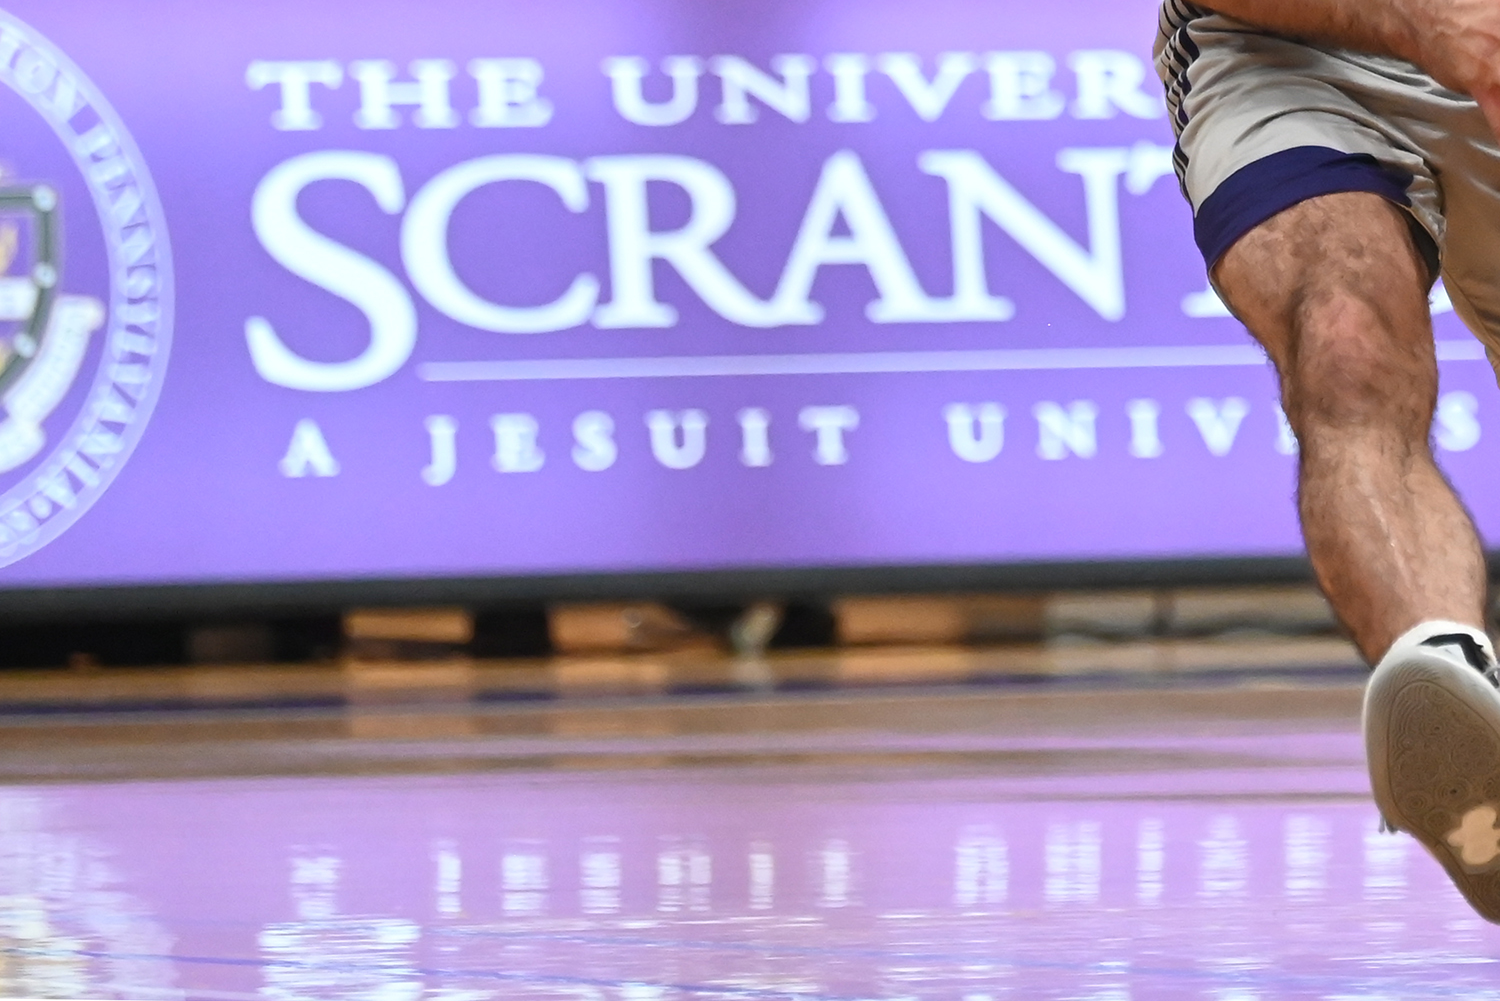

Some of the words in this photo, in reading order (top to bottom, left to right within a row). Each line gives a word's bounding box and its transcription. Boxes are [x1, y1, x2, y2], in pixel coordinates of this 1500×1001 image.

[245, 58, 554, 131] THE
[602, 49, 1167, 127] UNIVER
[279, 418, 341, 478] A
[420, 404, 860, 487] JESUIT
